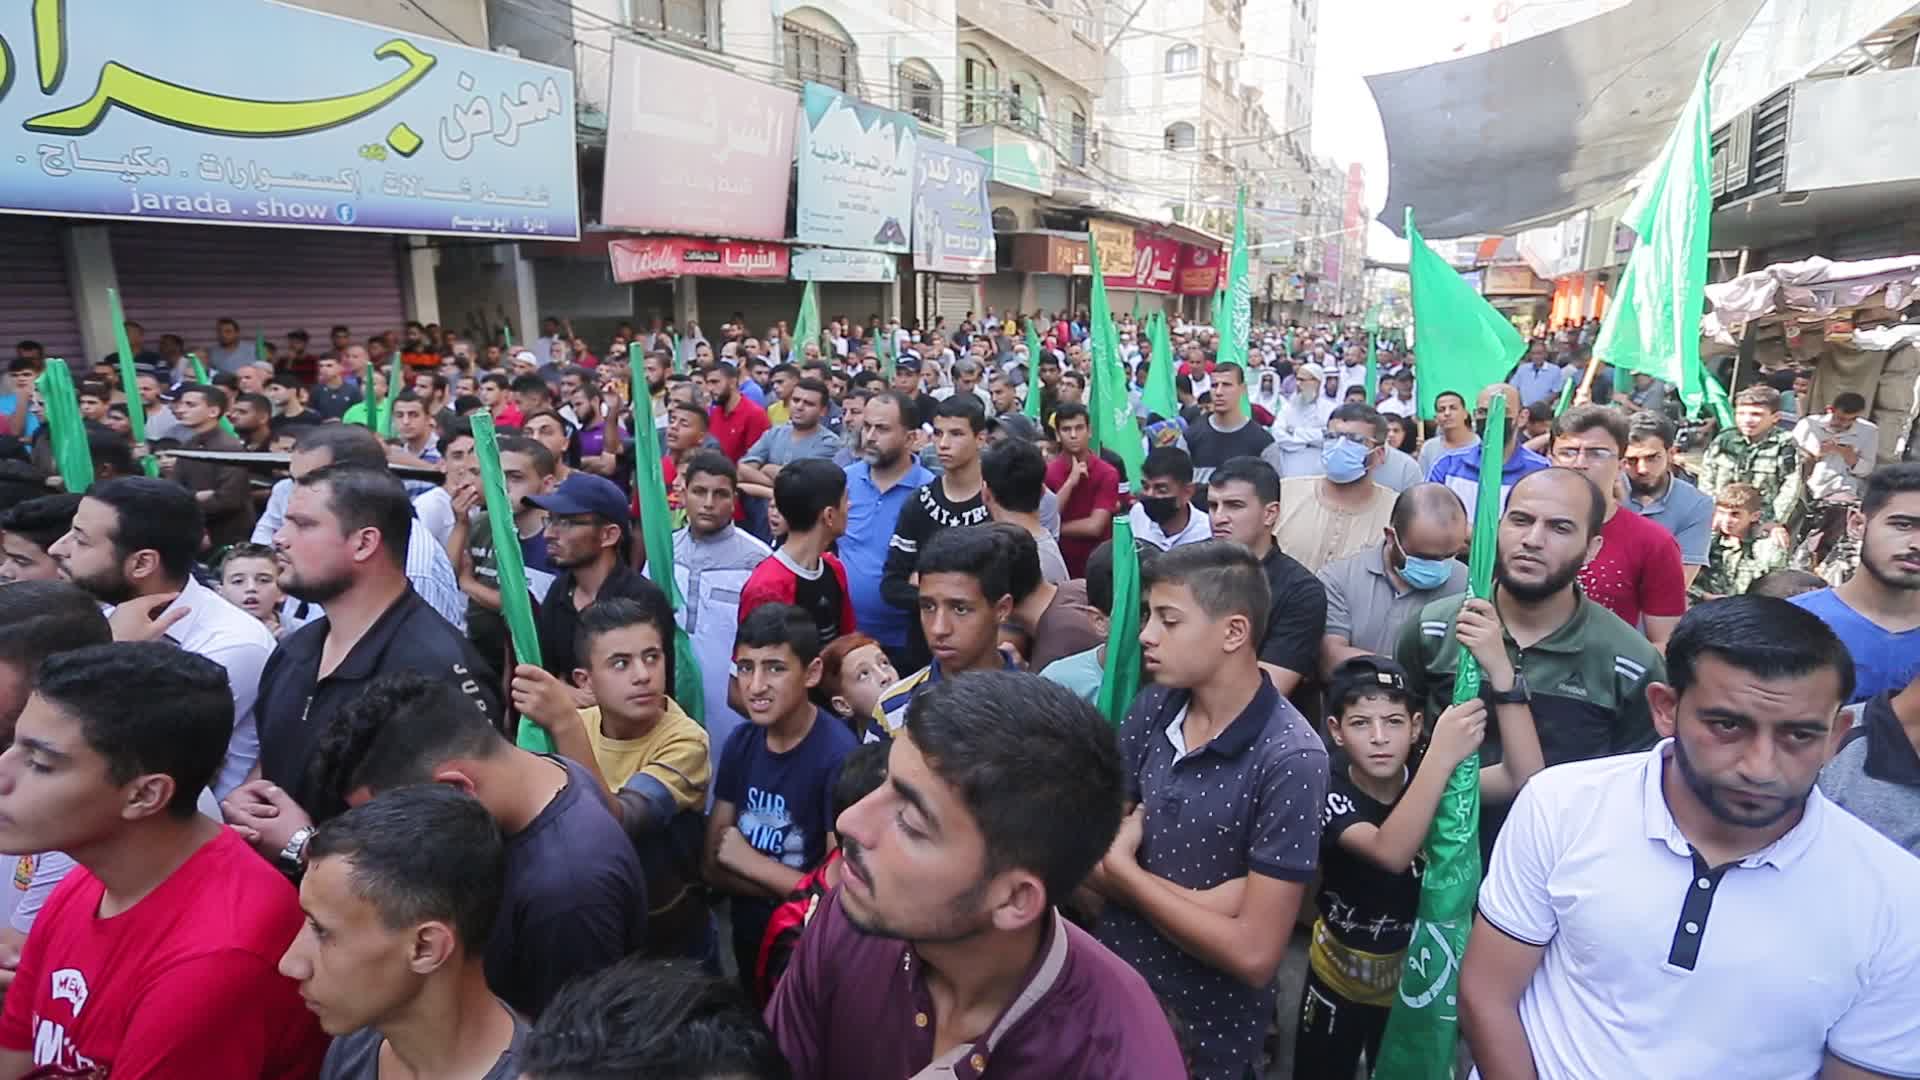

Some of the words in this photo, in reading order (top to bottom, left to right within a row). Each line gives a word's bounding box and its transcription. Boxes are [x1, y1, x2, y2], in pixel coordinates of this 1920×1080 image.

[0, 0, 437, 156] جرا
[439, 71, 563, 160] معرض
[37, 140, 169, 182] مكياج
[130, 187, 232, 214] jarada
[256, 196, 327, 220] show
[724, 244, 777, 274] الشرفا
